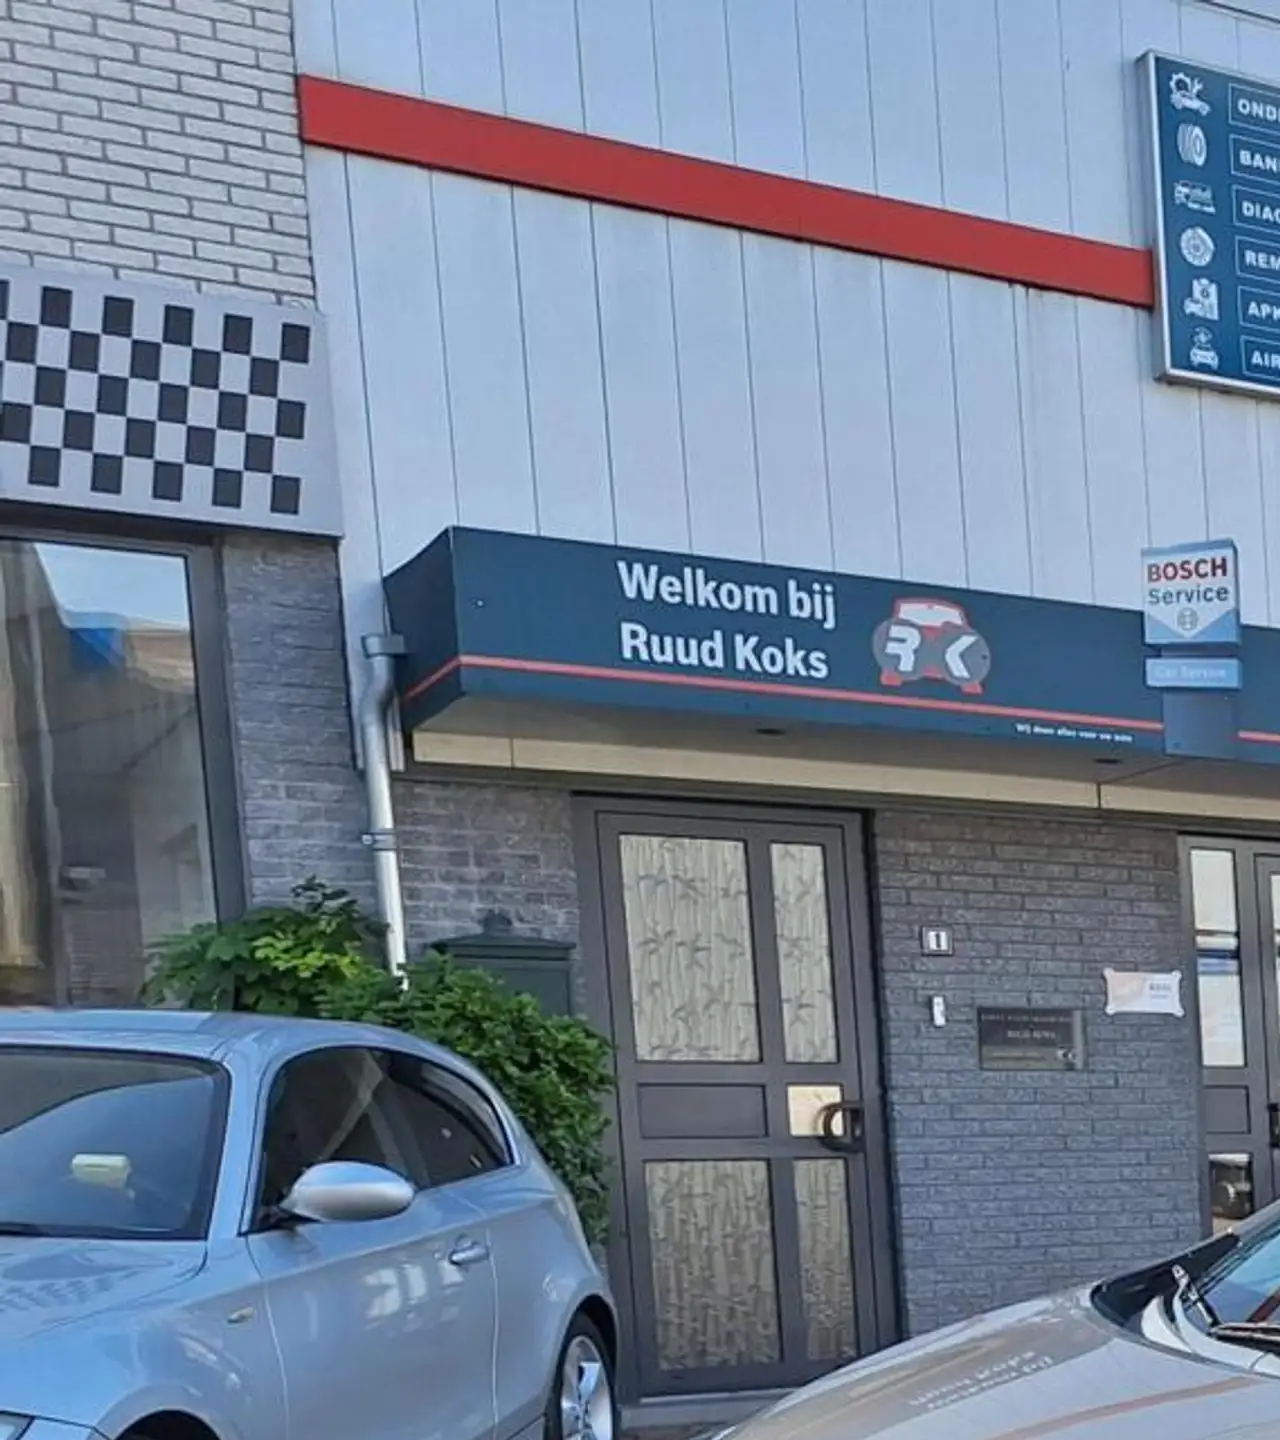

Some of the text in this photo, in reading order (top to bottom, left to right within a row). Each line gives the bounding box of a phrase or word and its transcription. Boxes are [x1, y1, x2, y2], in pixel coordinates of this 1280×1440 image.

[1147, 556, 1228, 584] BOSCH
[617, 560, 837, 631] Welkom bij
[1148, 583, 1230, 605] Service
[619, 622, 829, 680] Ruud Koks
